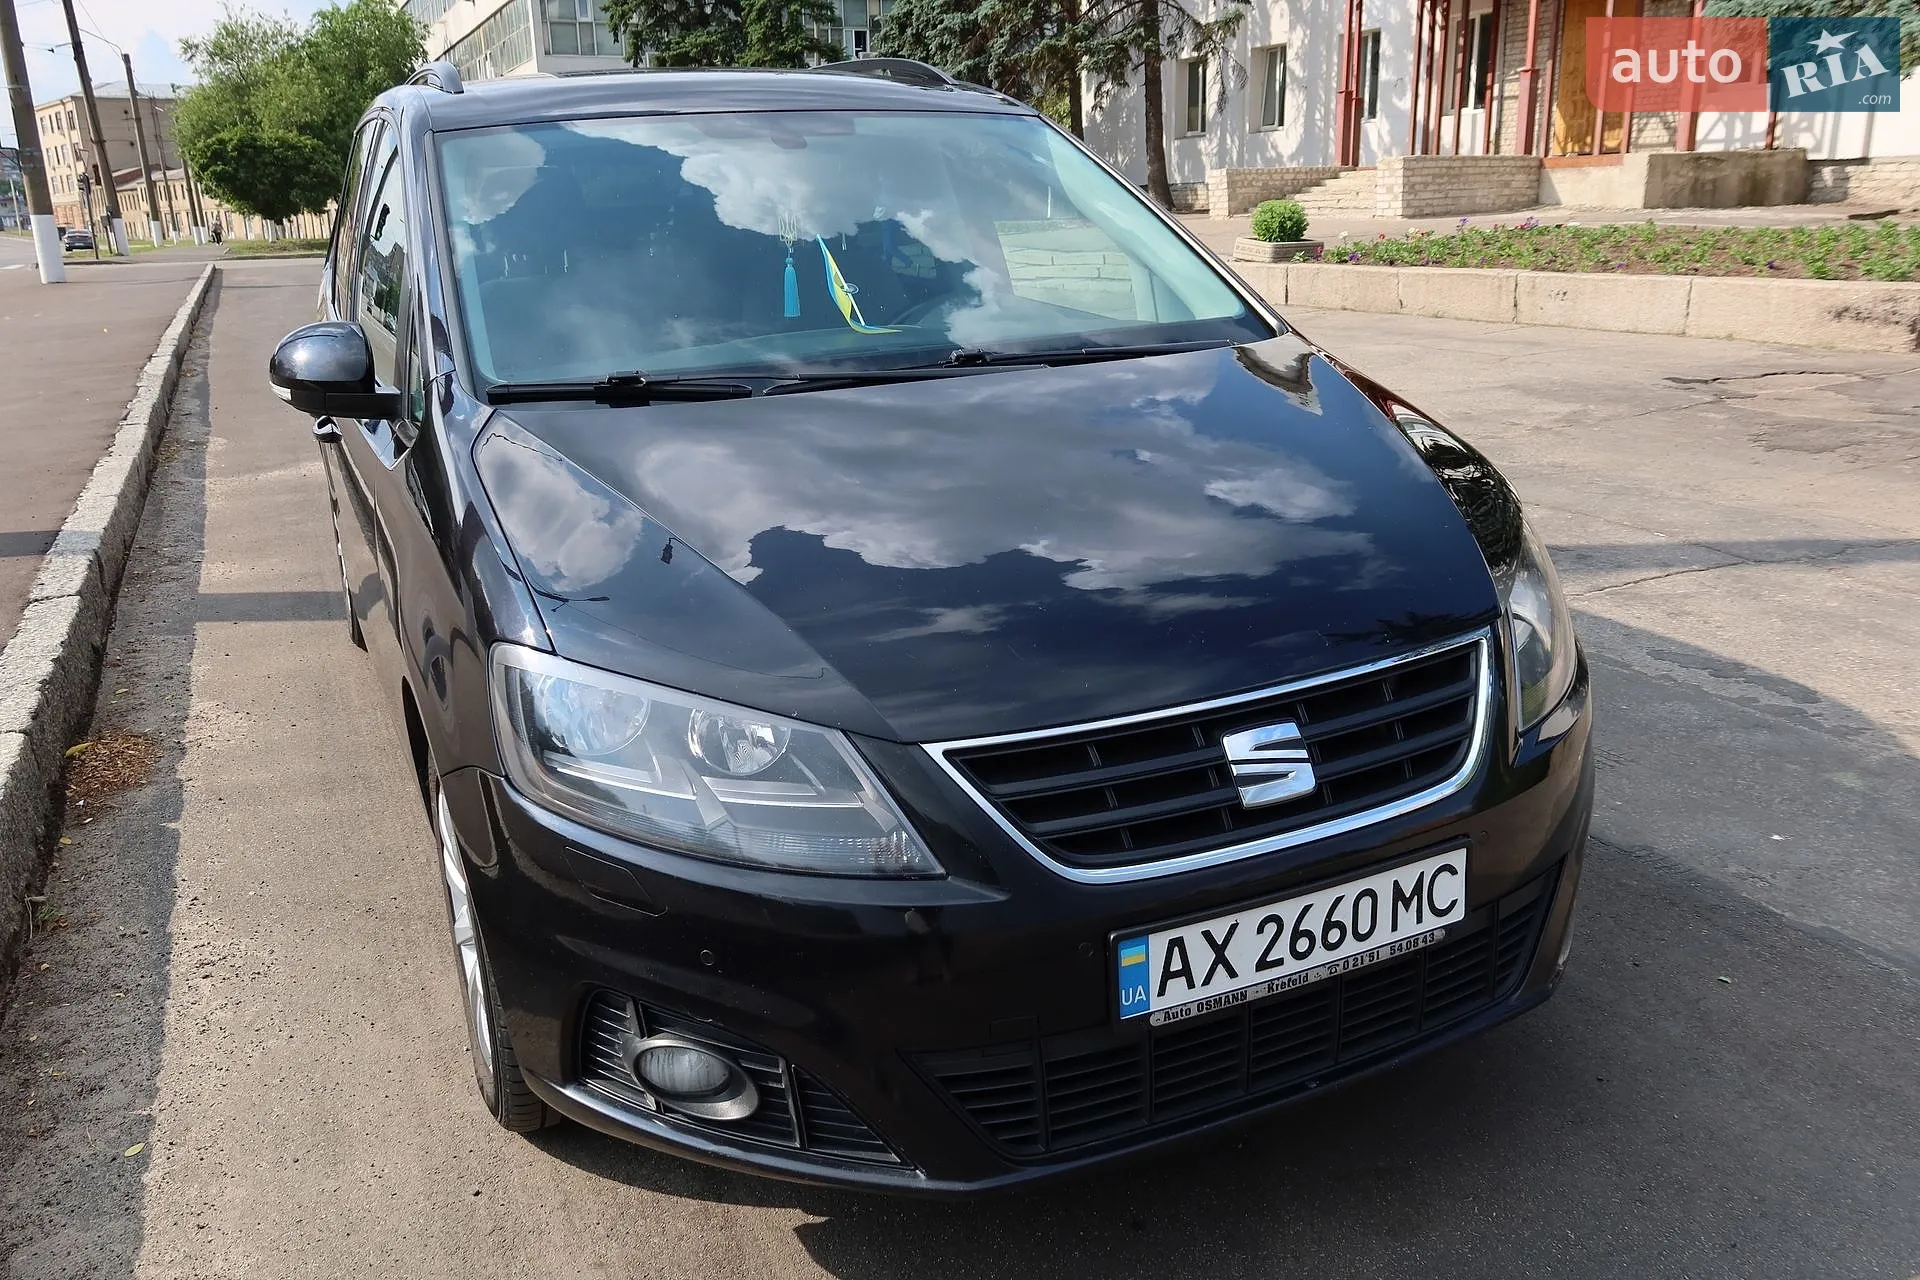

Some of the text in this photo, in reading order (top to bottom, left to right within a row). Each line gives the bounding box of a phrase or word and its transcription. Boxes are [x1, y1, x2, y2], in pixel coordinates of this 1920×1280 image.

[1156, 863, 1459, 998] AX 2660 MC
[1121, 985, 1147, 1007] UA
[1163, 1007, 1192, 1023] Auto
[1196, 990, 1248, 1013] OSMANN
[1266, 973, 1309, 994] Krefeld
